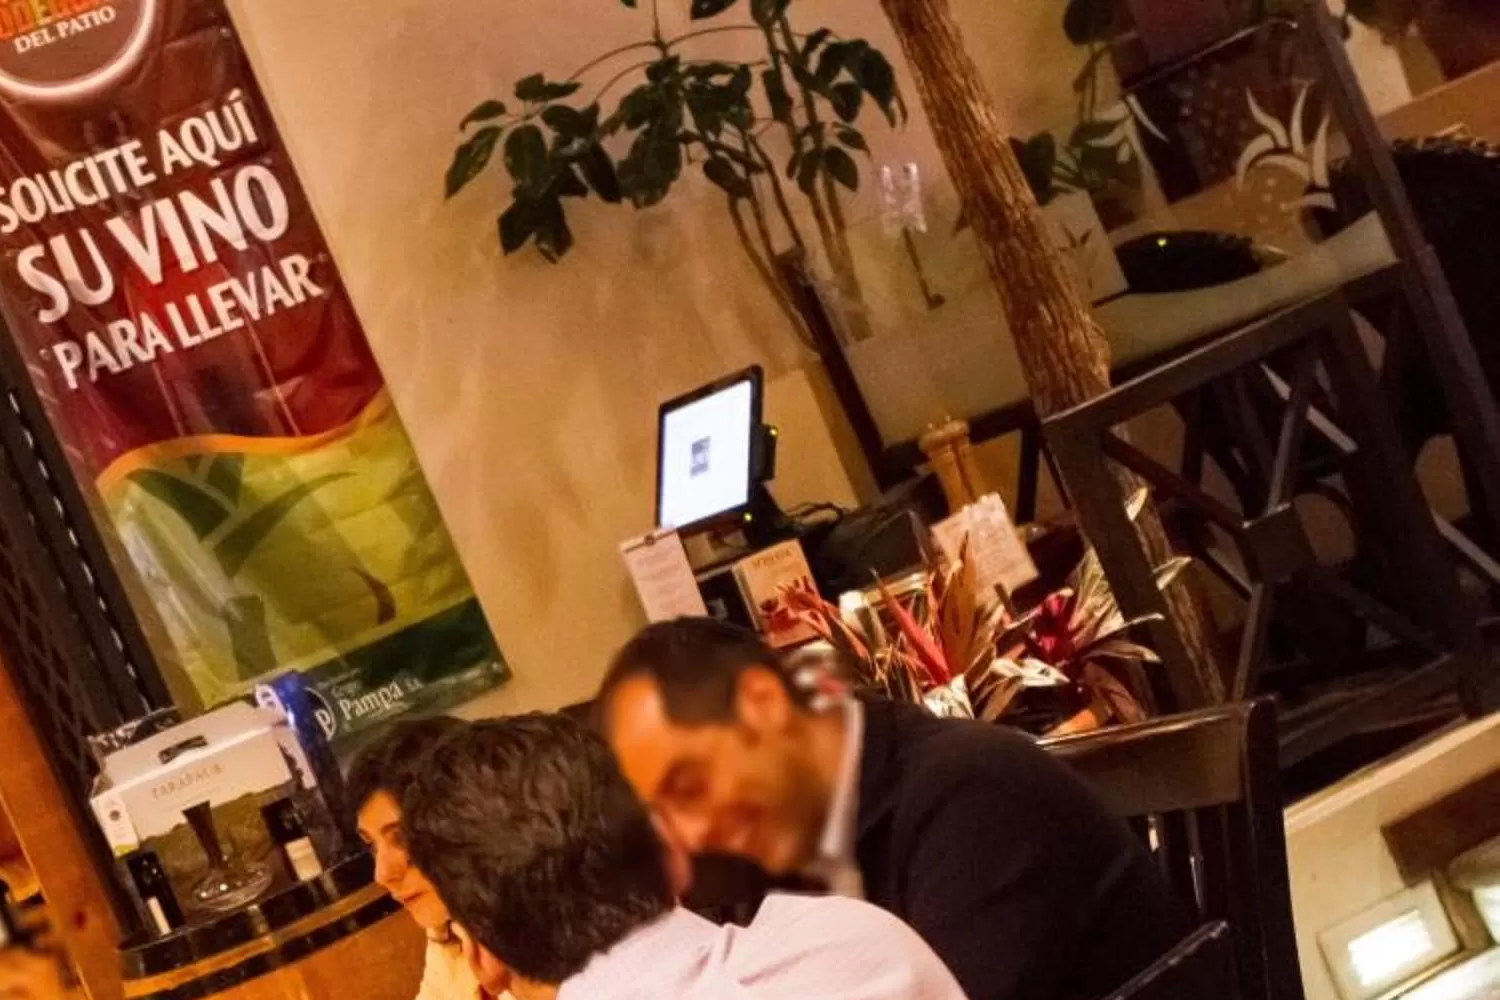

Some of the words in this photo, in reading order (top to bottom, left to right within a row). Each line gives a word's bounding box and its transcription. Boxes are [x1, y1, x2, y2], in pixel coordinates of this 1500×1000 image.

[13, 28, 56, 54] DEL
[55, 5, 117, 39] PATIO
[162, 88, 259, 174] AQUÍ
[16, 226, 115, 325] SU
[107, 163, 291, 287] VINO
[53, 302, 175, 390] PARA
[165, 253, 324, 348] LLEVAR
[337, 680, 405, 721] Pampa
